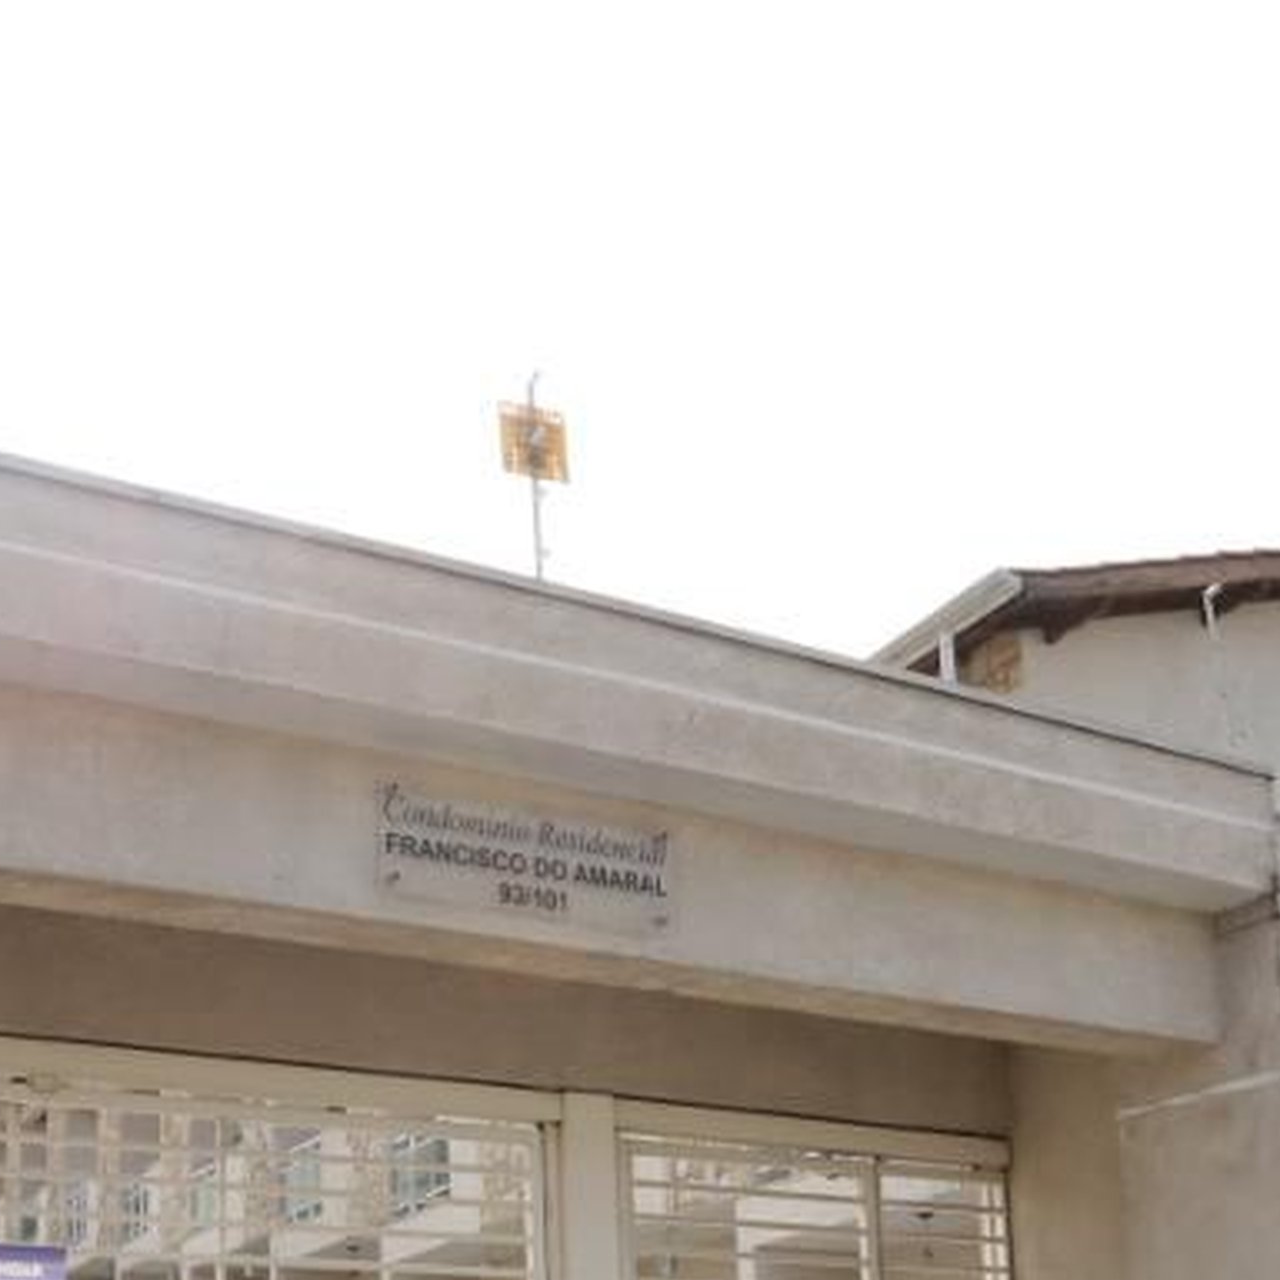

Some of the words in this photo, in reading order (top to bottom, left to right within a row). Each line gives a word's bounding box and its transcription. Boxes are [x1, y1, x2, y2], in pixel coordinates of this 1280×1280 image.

[384, 831, 528, 876] FRANCISCO
[534, 860, 567, 882] DO
[573, 863, 667, 899] AMARAL
[539, 821, 667, 867] Residencial
[498, 882, 568, 912] 93/101
